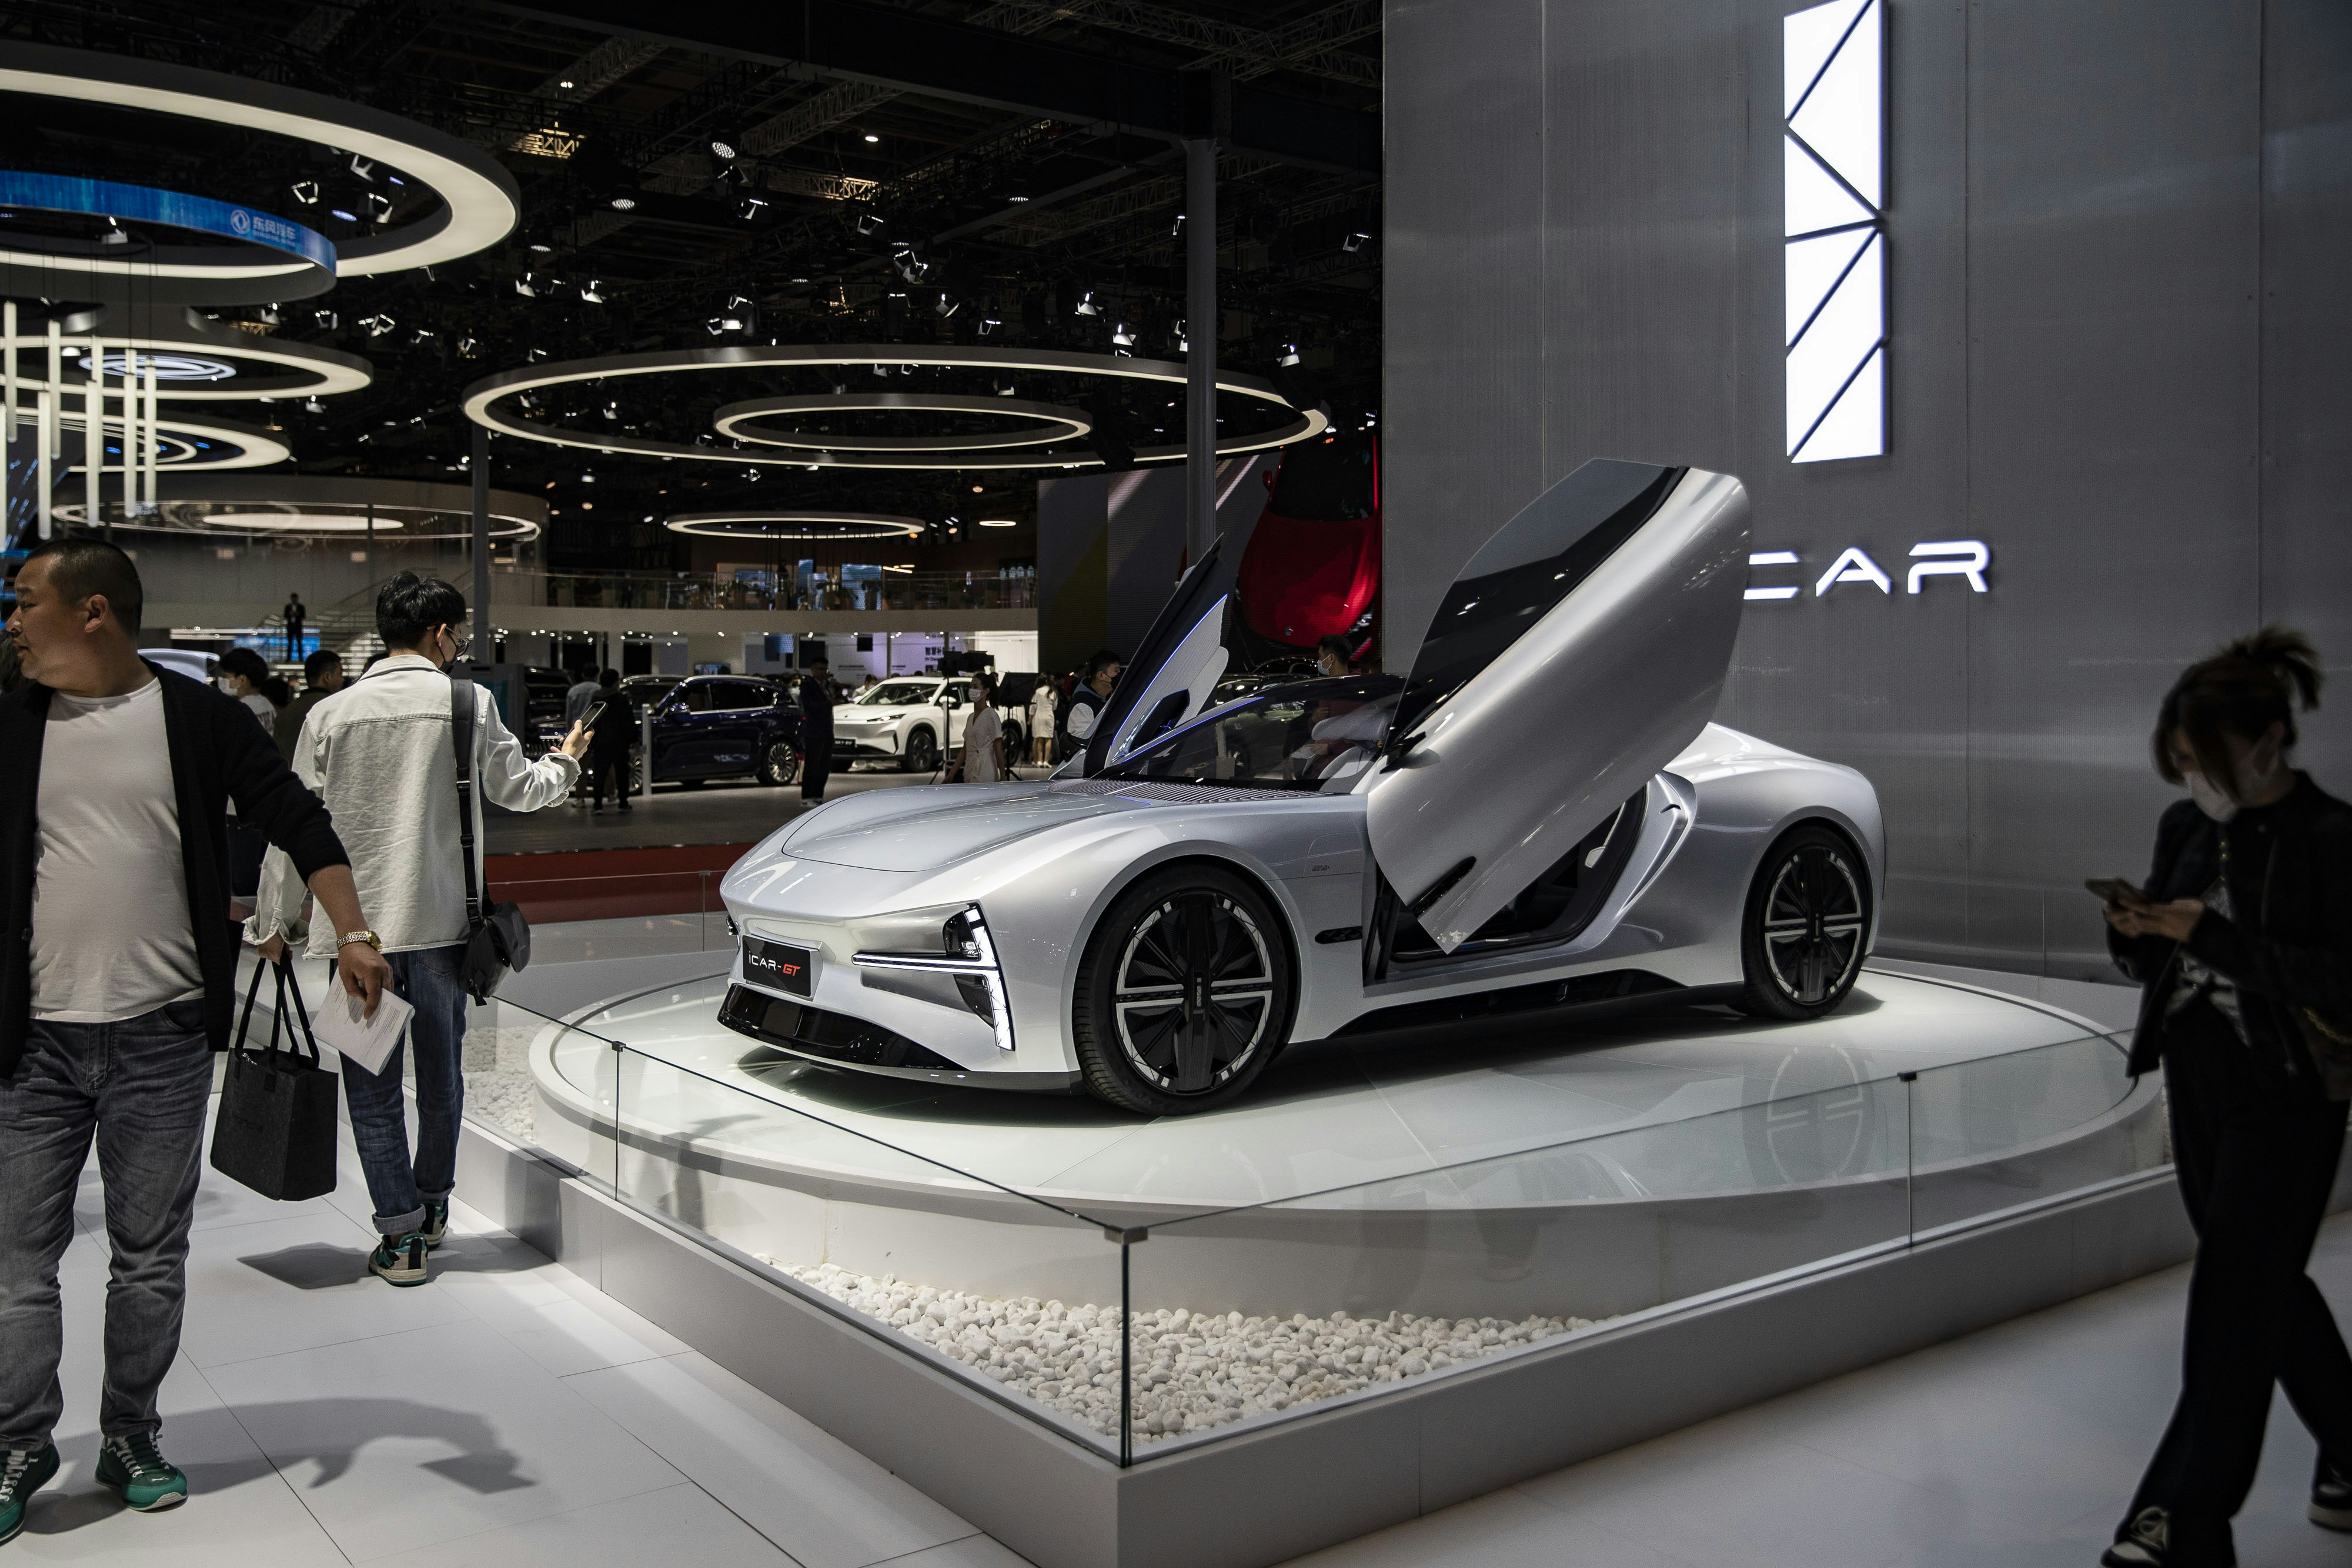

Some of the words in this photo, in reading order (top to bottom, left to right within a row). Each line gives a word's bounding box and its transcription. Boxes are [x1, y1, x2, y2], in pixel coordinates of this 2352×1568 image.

[253, 216, 296, 240] 东风汽车
[749, 951, 801, 977] iCAR-GT
